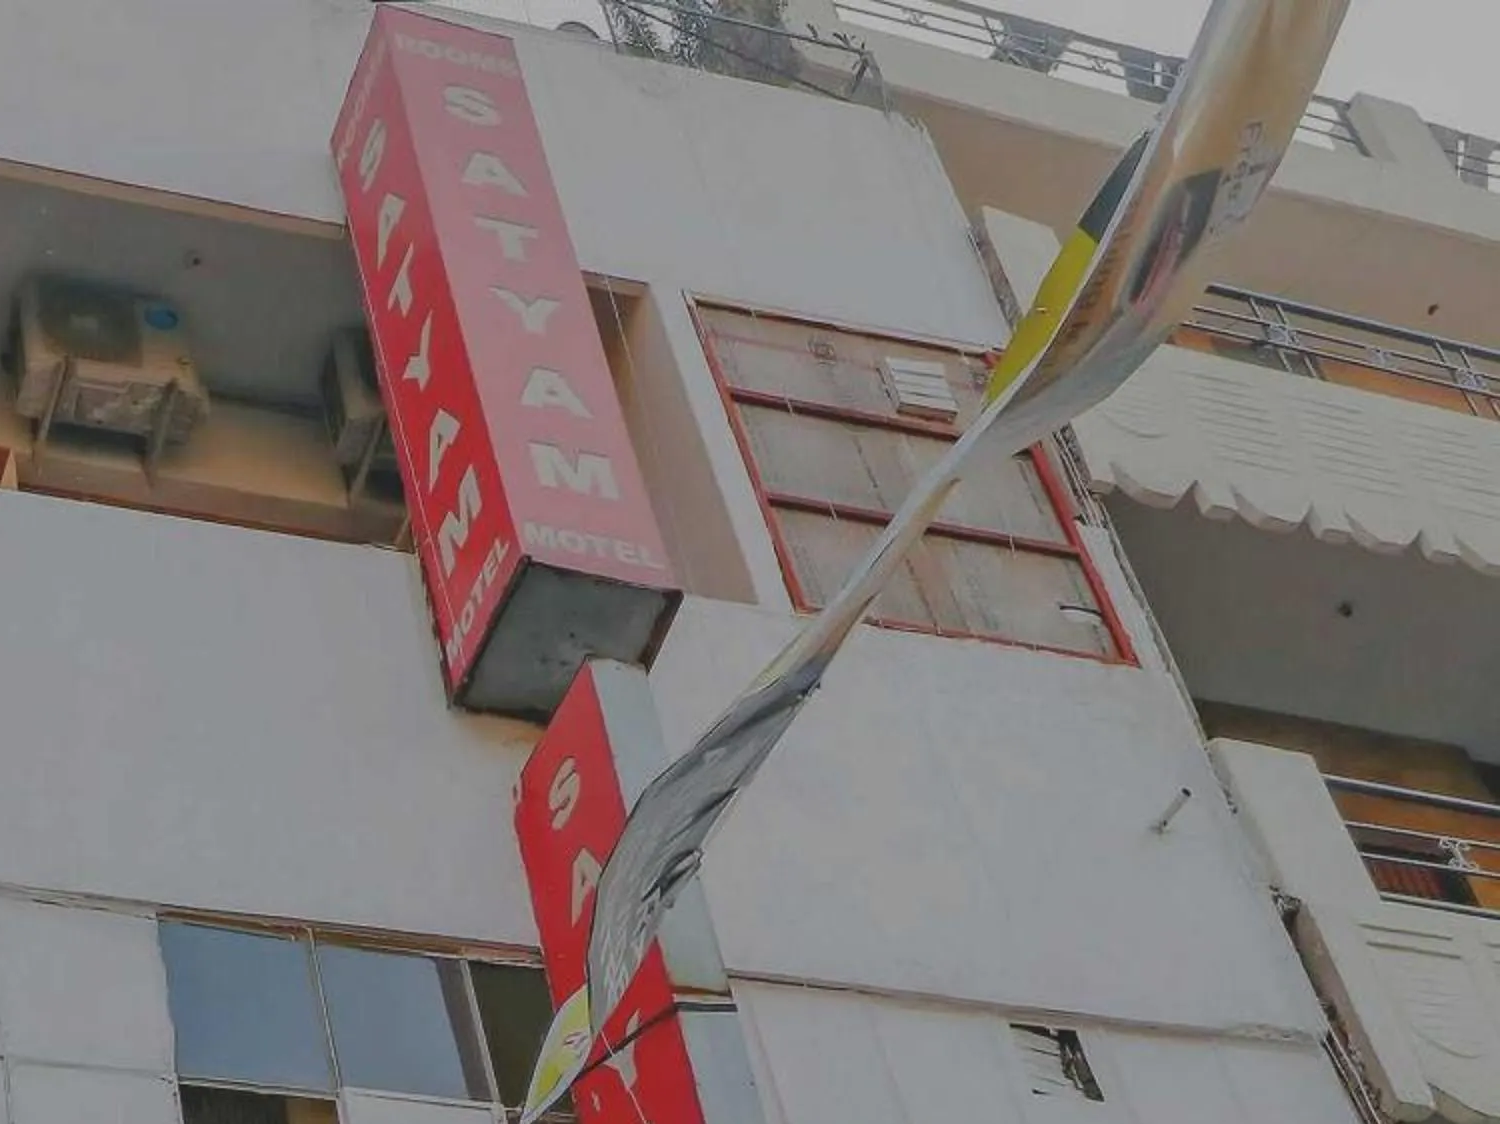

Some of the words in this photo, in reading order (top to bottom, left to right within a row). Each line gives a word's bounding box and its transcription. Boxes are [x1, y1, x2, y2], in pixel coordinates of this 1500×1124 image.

[358, 118, 483, 575] SATYAM
[442, 85, 621, 501] SATYAM
[446, 537, 510, 670] MOTEL
[522, 520, 666, 571] MOTEL
